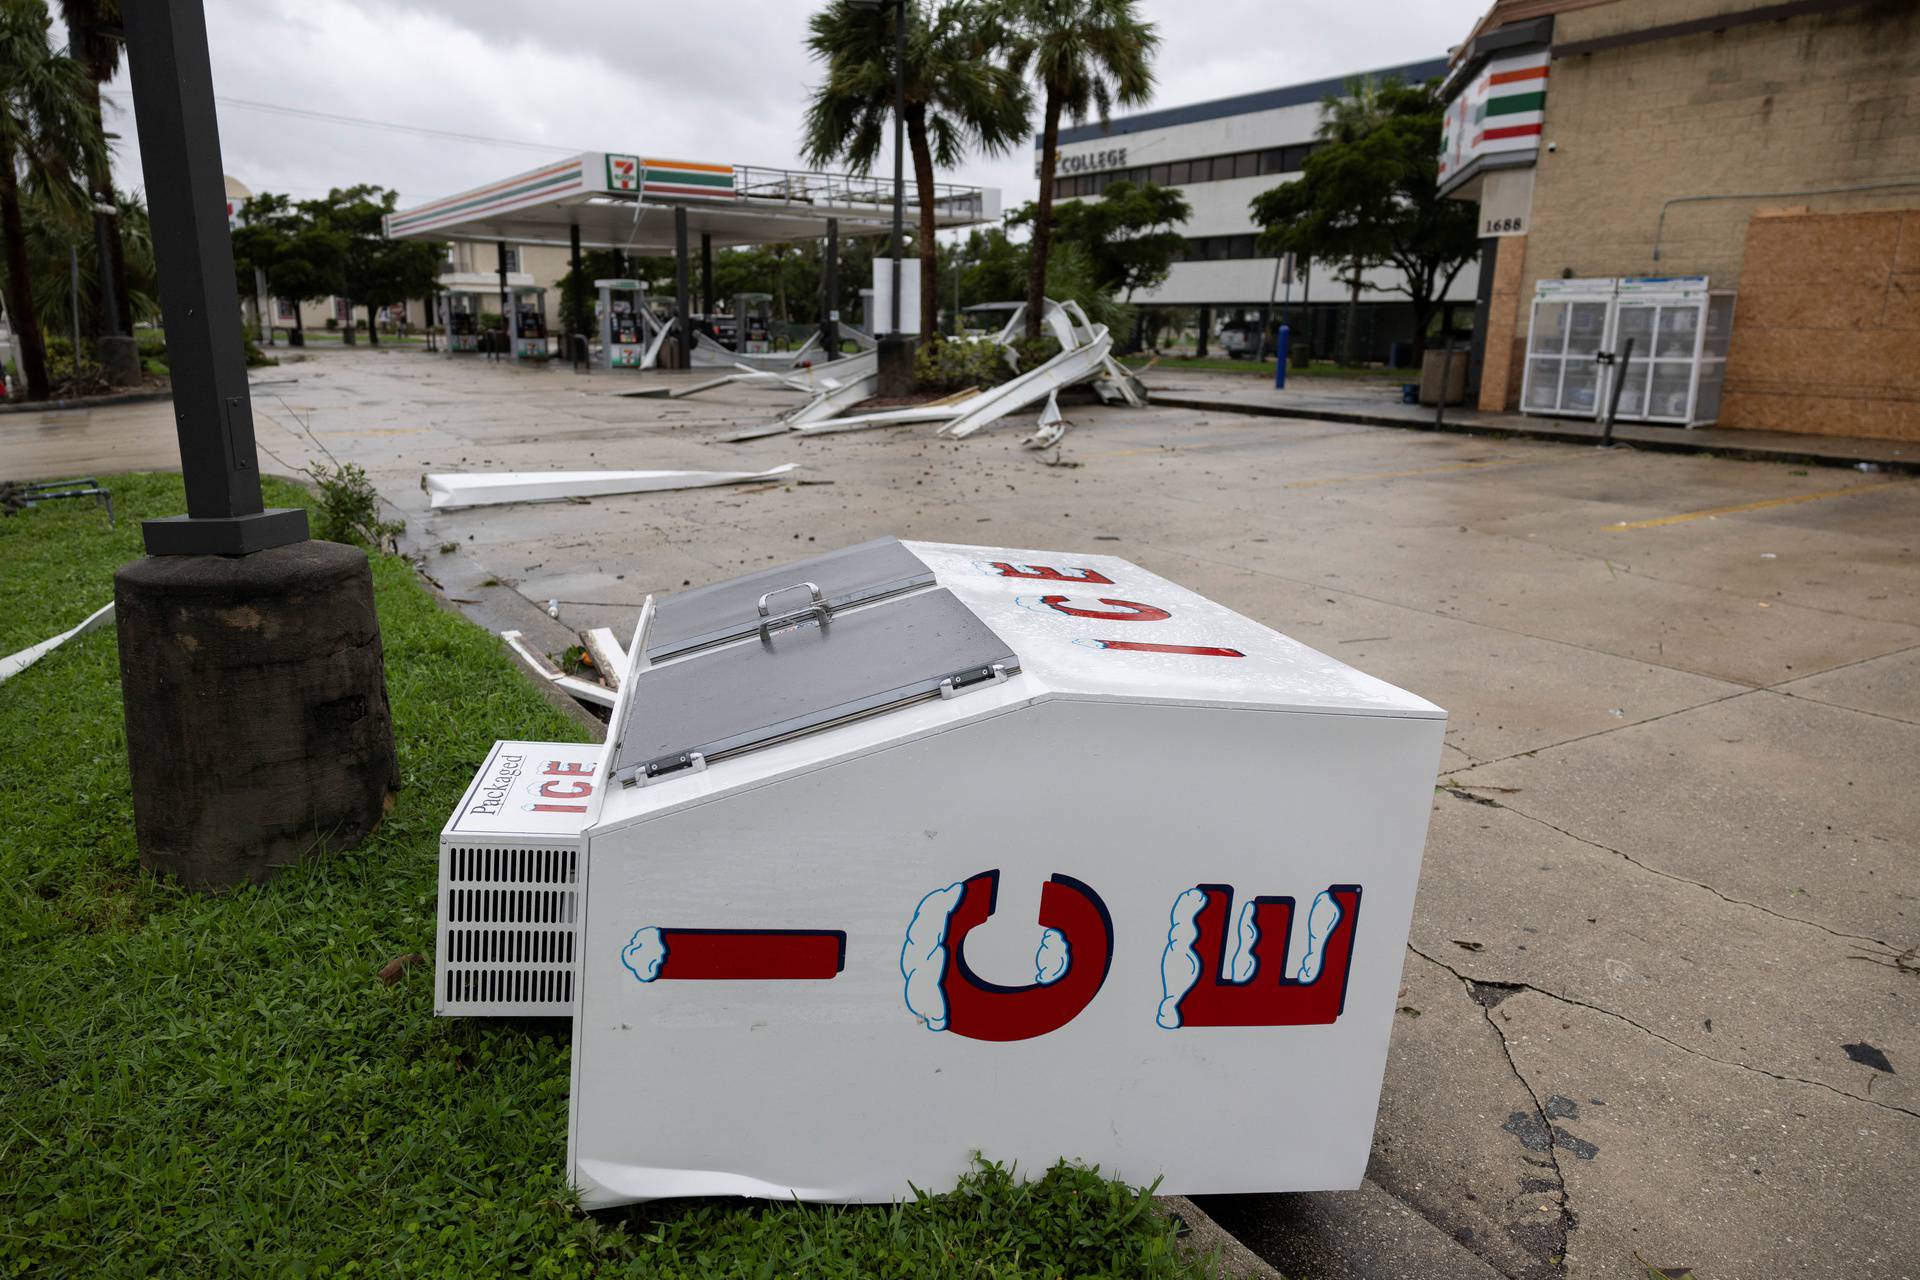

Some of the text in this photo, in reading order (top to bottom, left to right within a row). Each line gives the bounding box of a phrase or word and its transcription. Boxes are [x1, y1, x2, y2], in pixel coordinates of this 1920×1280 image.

[614, 160, 635, 189] 7
[1061, 148, 1127, 173] COLLEGE
[1487, 217, 1522, 233] 1688
[972, 560, 1247, 658] ICE
[469, 754, 523, 816] Packaged
[520, 760, 597, 813] ICE
[621, 868, 1364, 1043] ICE
